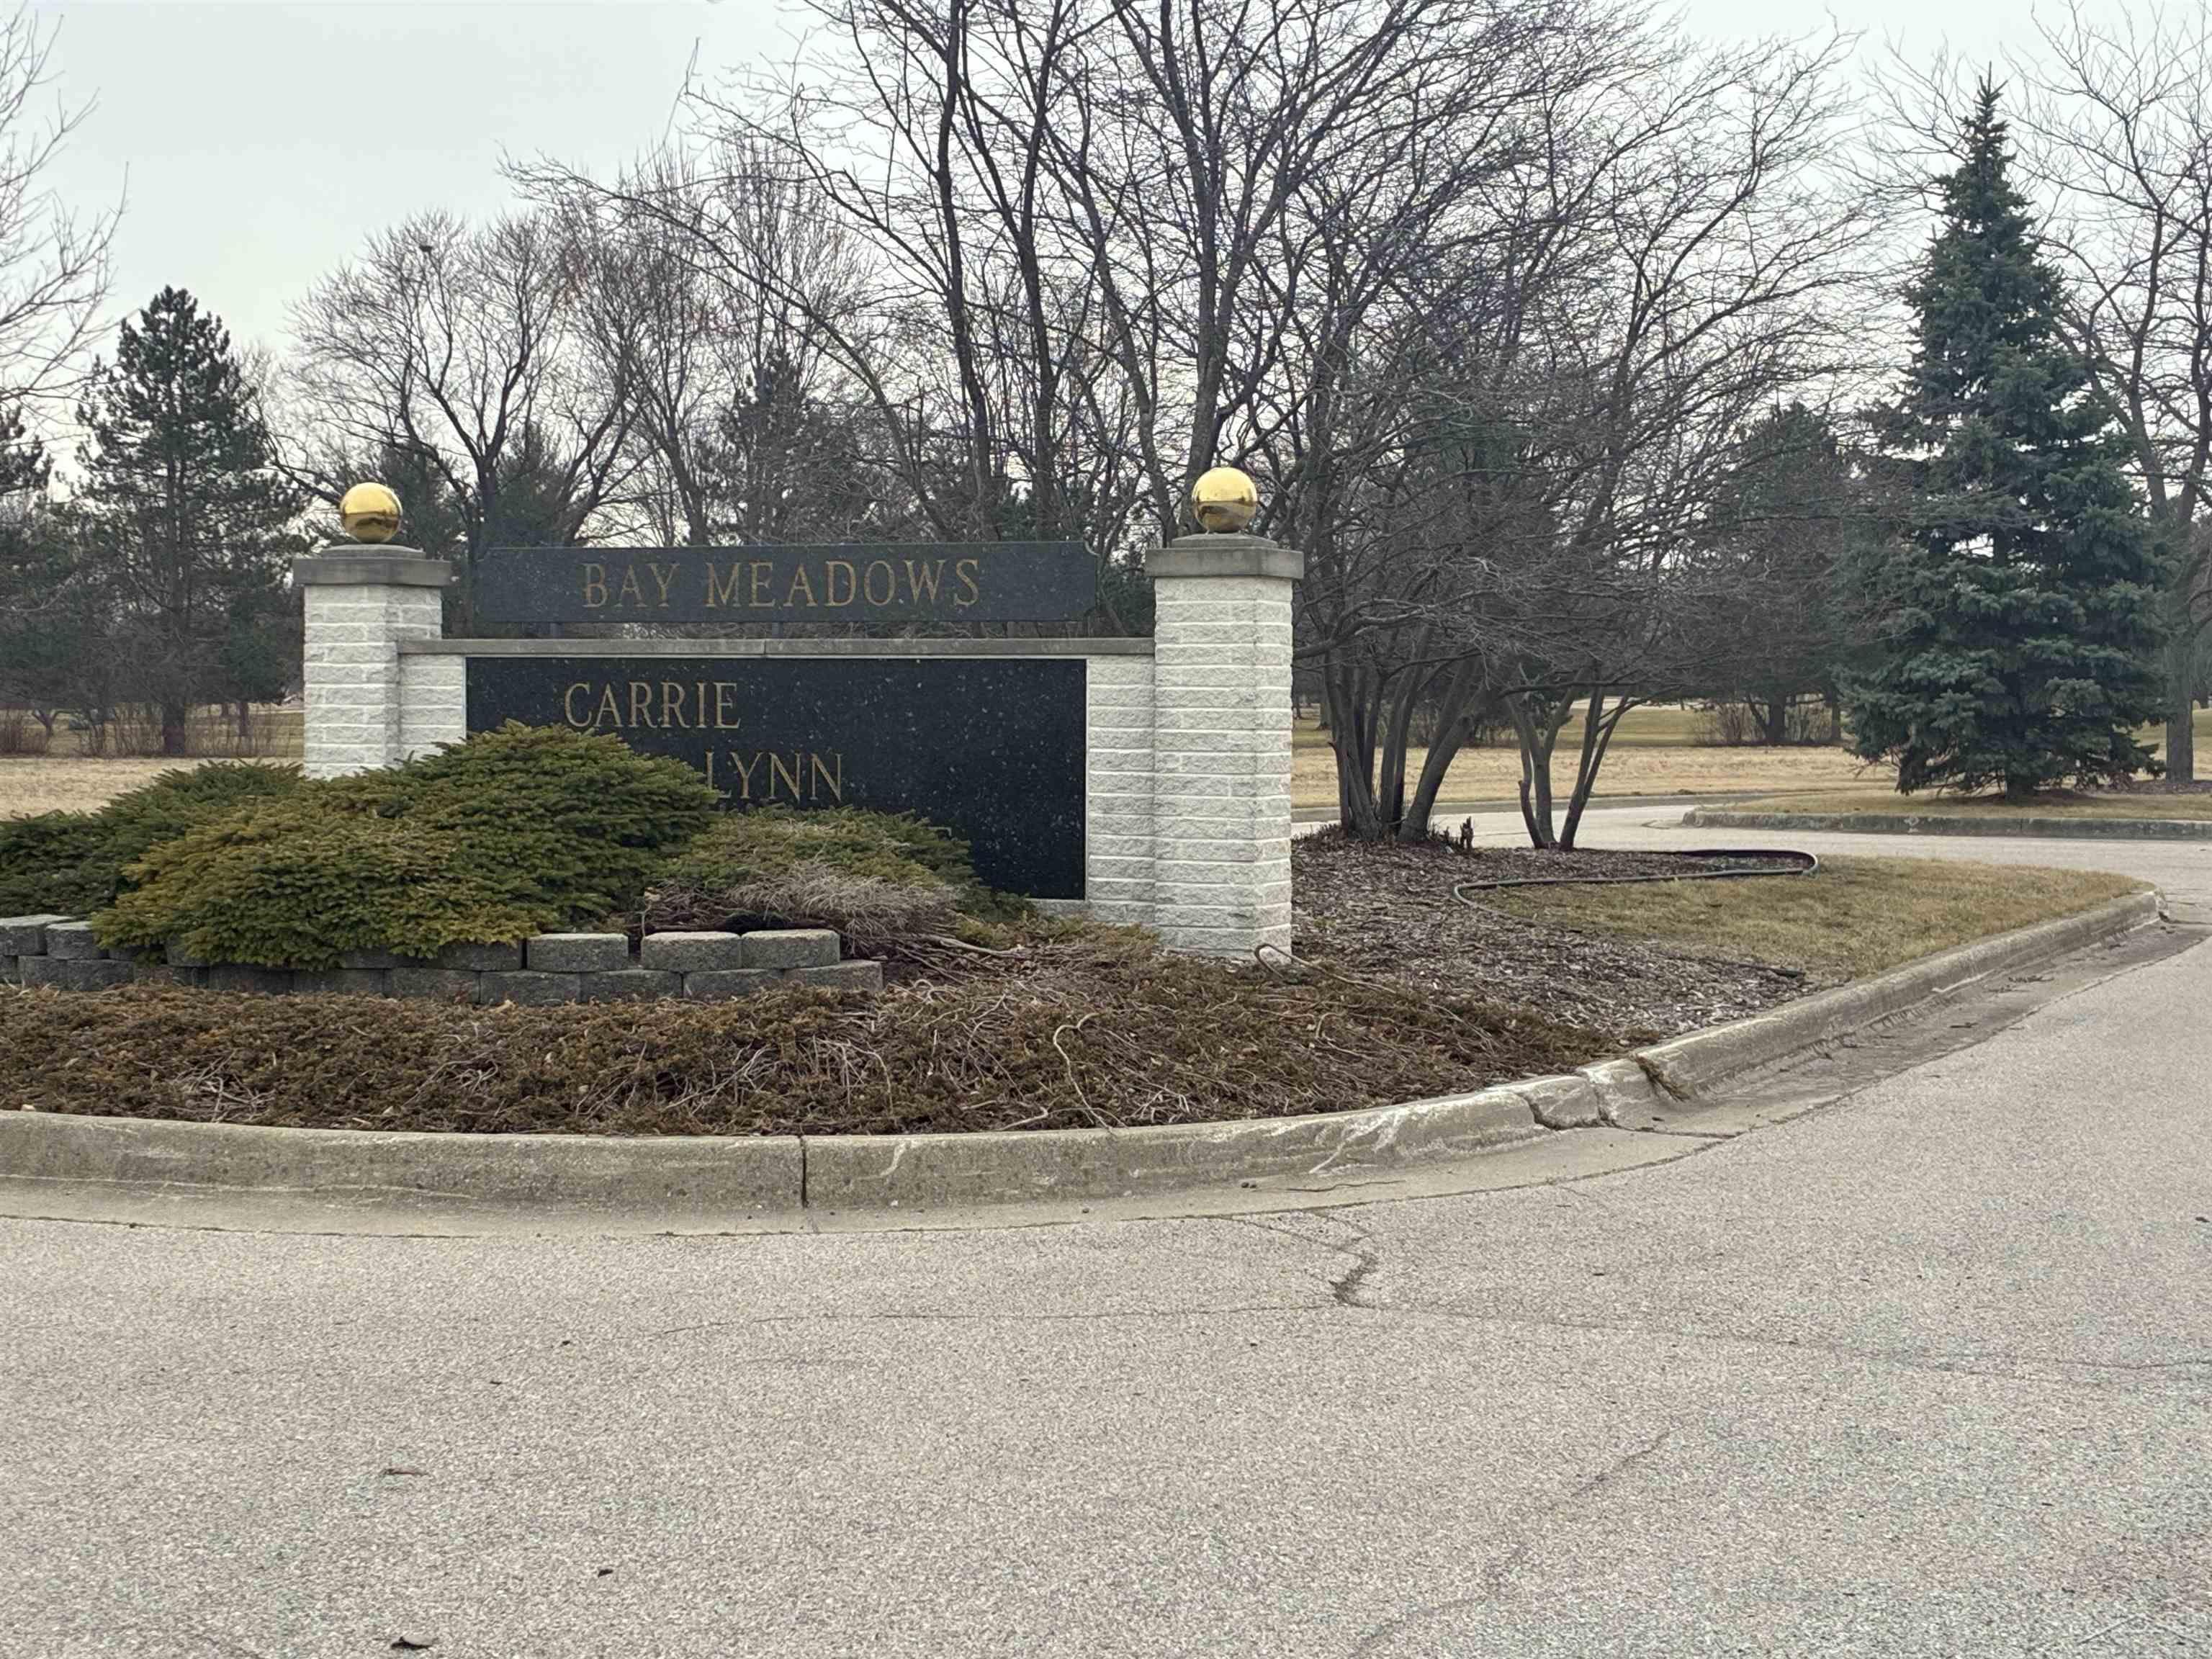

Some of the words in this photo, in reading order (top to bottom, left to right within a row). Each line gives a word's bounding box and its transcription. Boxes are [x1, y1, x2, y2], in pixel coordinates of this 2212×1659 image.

[582, 562, 680, 608] BAY
[703, 559, 980, 608] MEADOWS
[564, 681, 742, 729] CARRIE
[704, 751, 844, 802] LYNN
